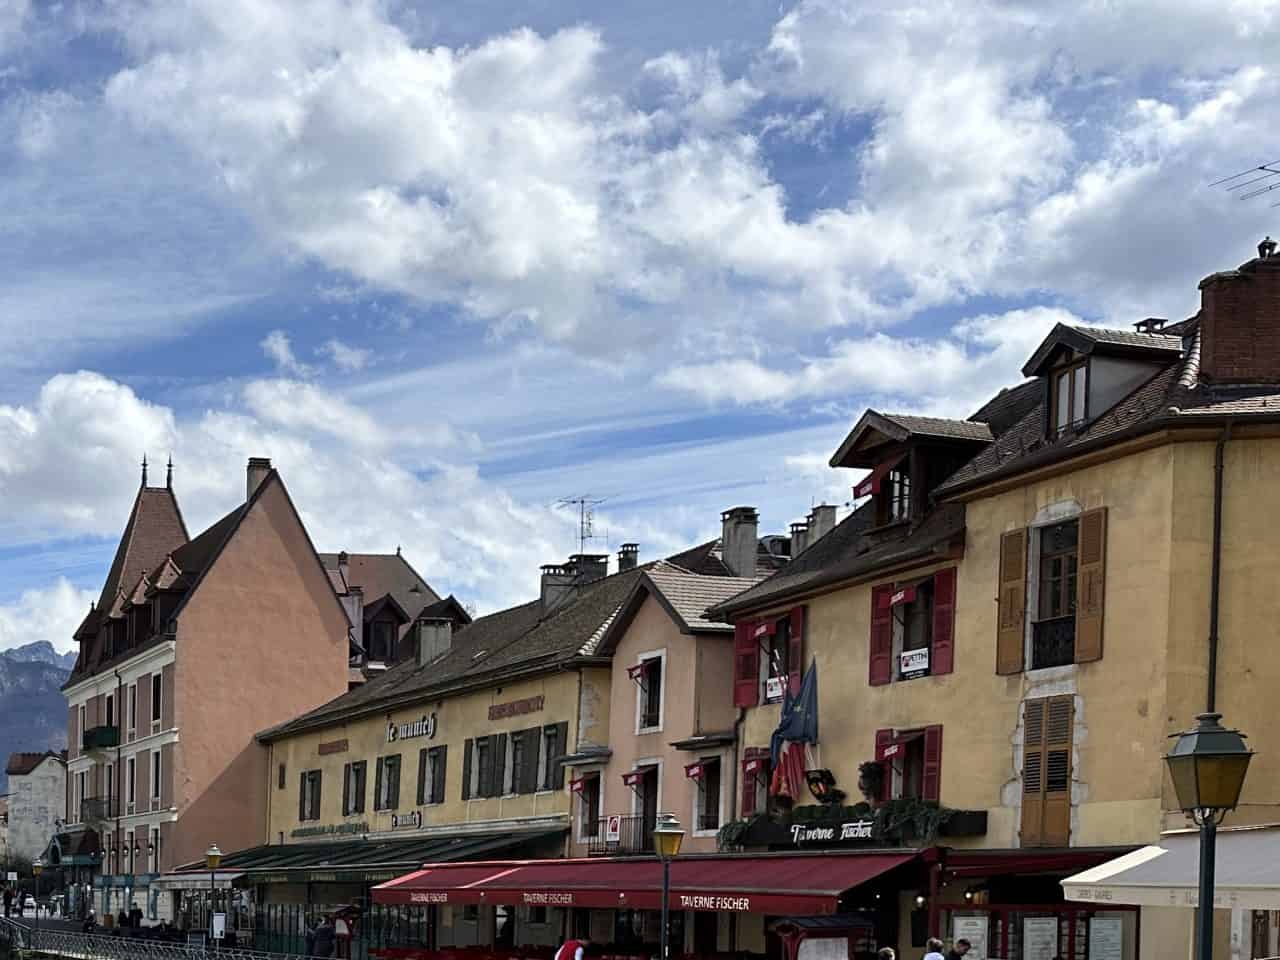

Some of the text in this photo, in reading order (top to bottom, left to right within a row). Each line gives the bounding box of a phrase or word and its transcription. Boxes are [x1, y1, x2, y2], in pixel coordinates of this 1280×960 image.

[791, 824, 834, 843] Taverne
[523, 893, 572, 904] TAVERNE FISCHER
[680, 895, 750, 910] TAVERNE FISCHER
